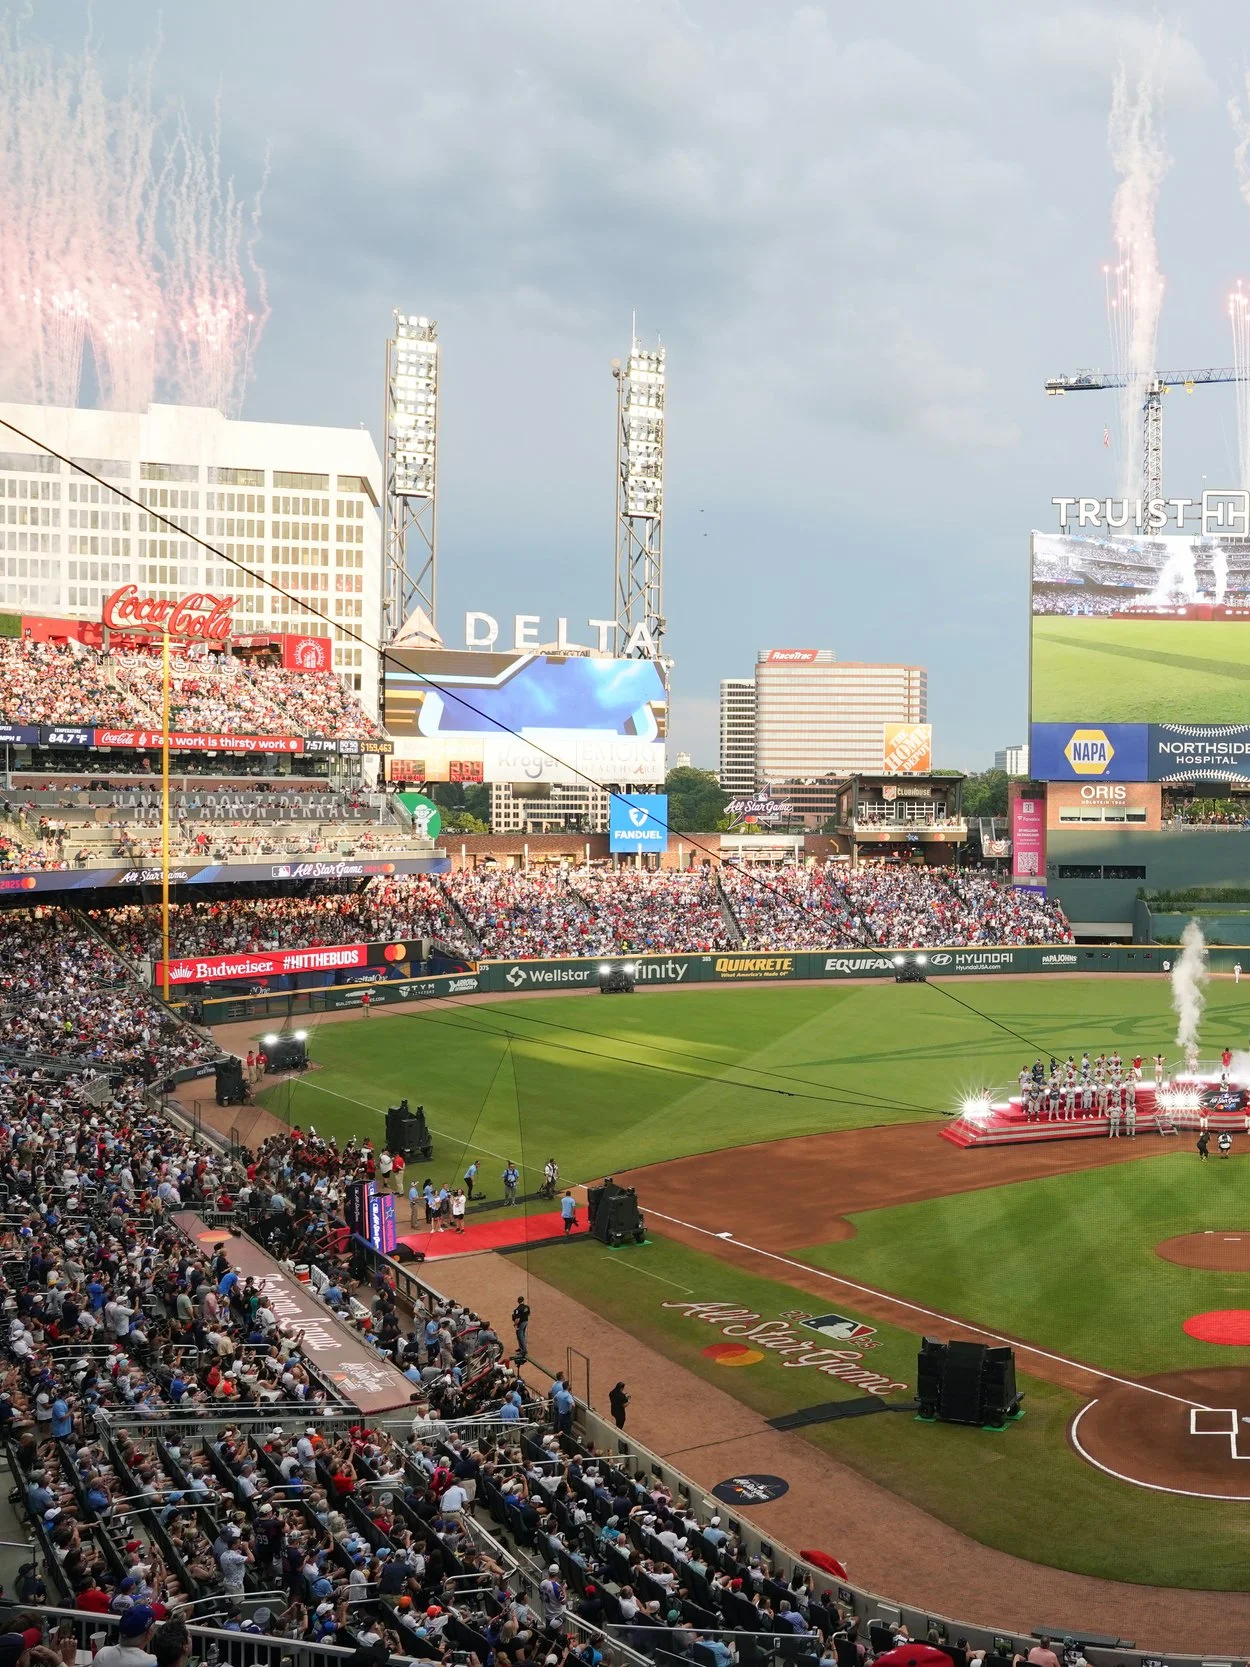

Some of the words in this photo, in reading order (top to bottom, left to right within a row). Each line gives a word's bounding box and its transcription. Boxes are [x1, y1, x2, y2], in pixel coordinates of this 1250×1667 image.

[1052, 497, 1193, 528] TRUIST
[103, 584, 240, 640] Coca-Cola
[465, 611, 658, 657] DELTA
[771, 651, 813, 662] RaceTrac
[48, 733, 74, 743] 84.7
[178, 736, 204, 748] work
[208, 736, 218, 748] is
[220, 737, 257, 751] thirsty
[258, 738, 287, 750] work
[323, 741, 336, 751] PM
[884, 725, 931, 772] HOME
[1072, 741, 1107, 763] NAPA
[902, 742, 931, 772] DEPOT
[1175, 756, 1238, 765] HOSPITAL
[897, 788, 932, 797] CLUBHOUSE
[1080, 785, 1126, 799] ORIS
[744, 800, 765, 813] Star
[613, 829, 663, 840] FANDUEL
[291, 863, 313, 878] All
[313, 864, 336, 876] Star
[335, 864, 363, 877] Game
[195, 960, 275, 979] Budweiser
[283, 949, 360, 971] #HITTHEBUDS
[715, 957, 793, 974] QUIKRETE
[825, 958, 898, 974] EQUIFAX
[955, 952, 1013, 964] HYUNDAI
[529, 967, 590, 983] Wellstar
[633, 959, 689, 984] finity
[955, 964, 1001, 972] HyundaiUSA.com
[661, 1300, 762, 1325] All
[721, 1320, 814, 1356] Star
[782, 1340, 909, 1396] Game
